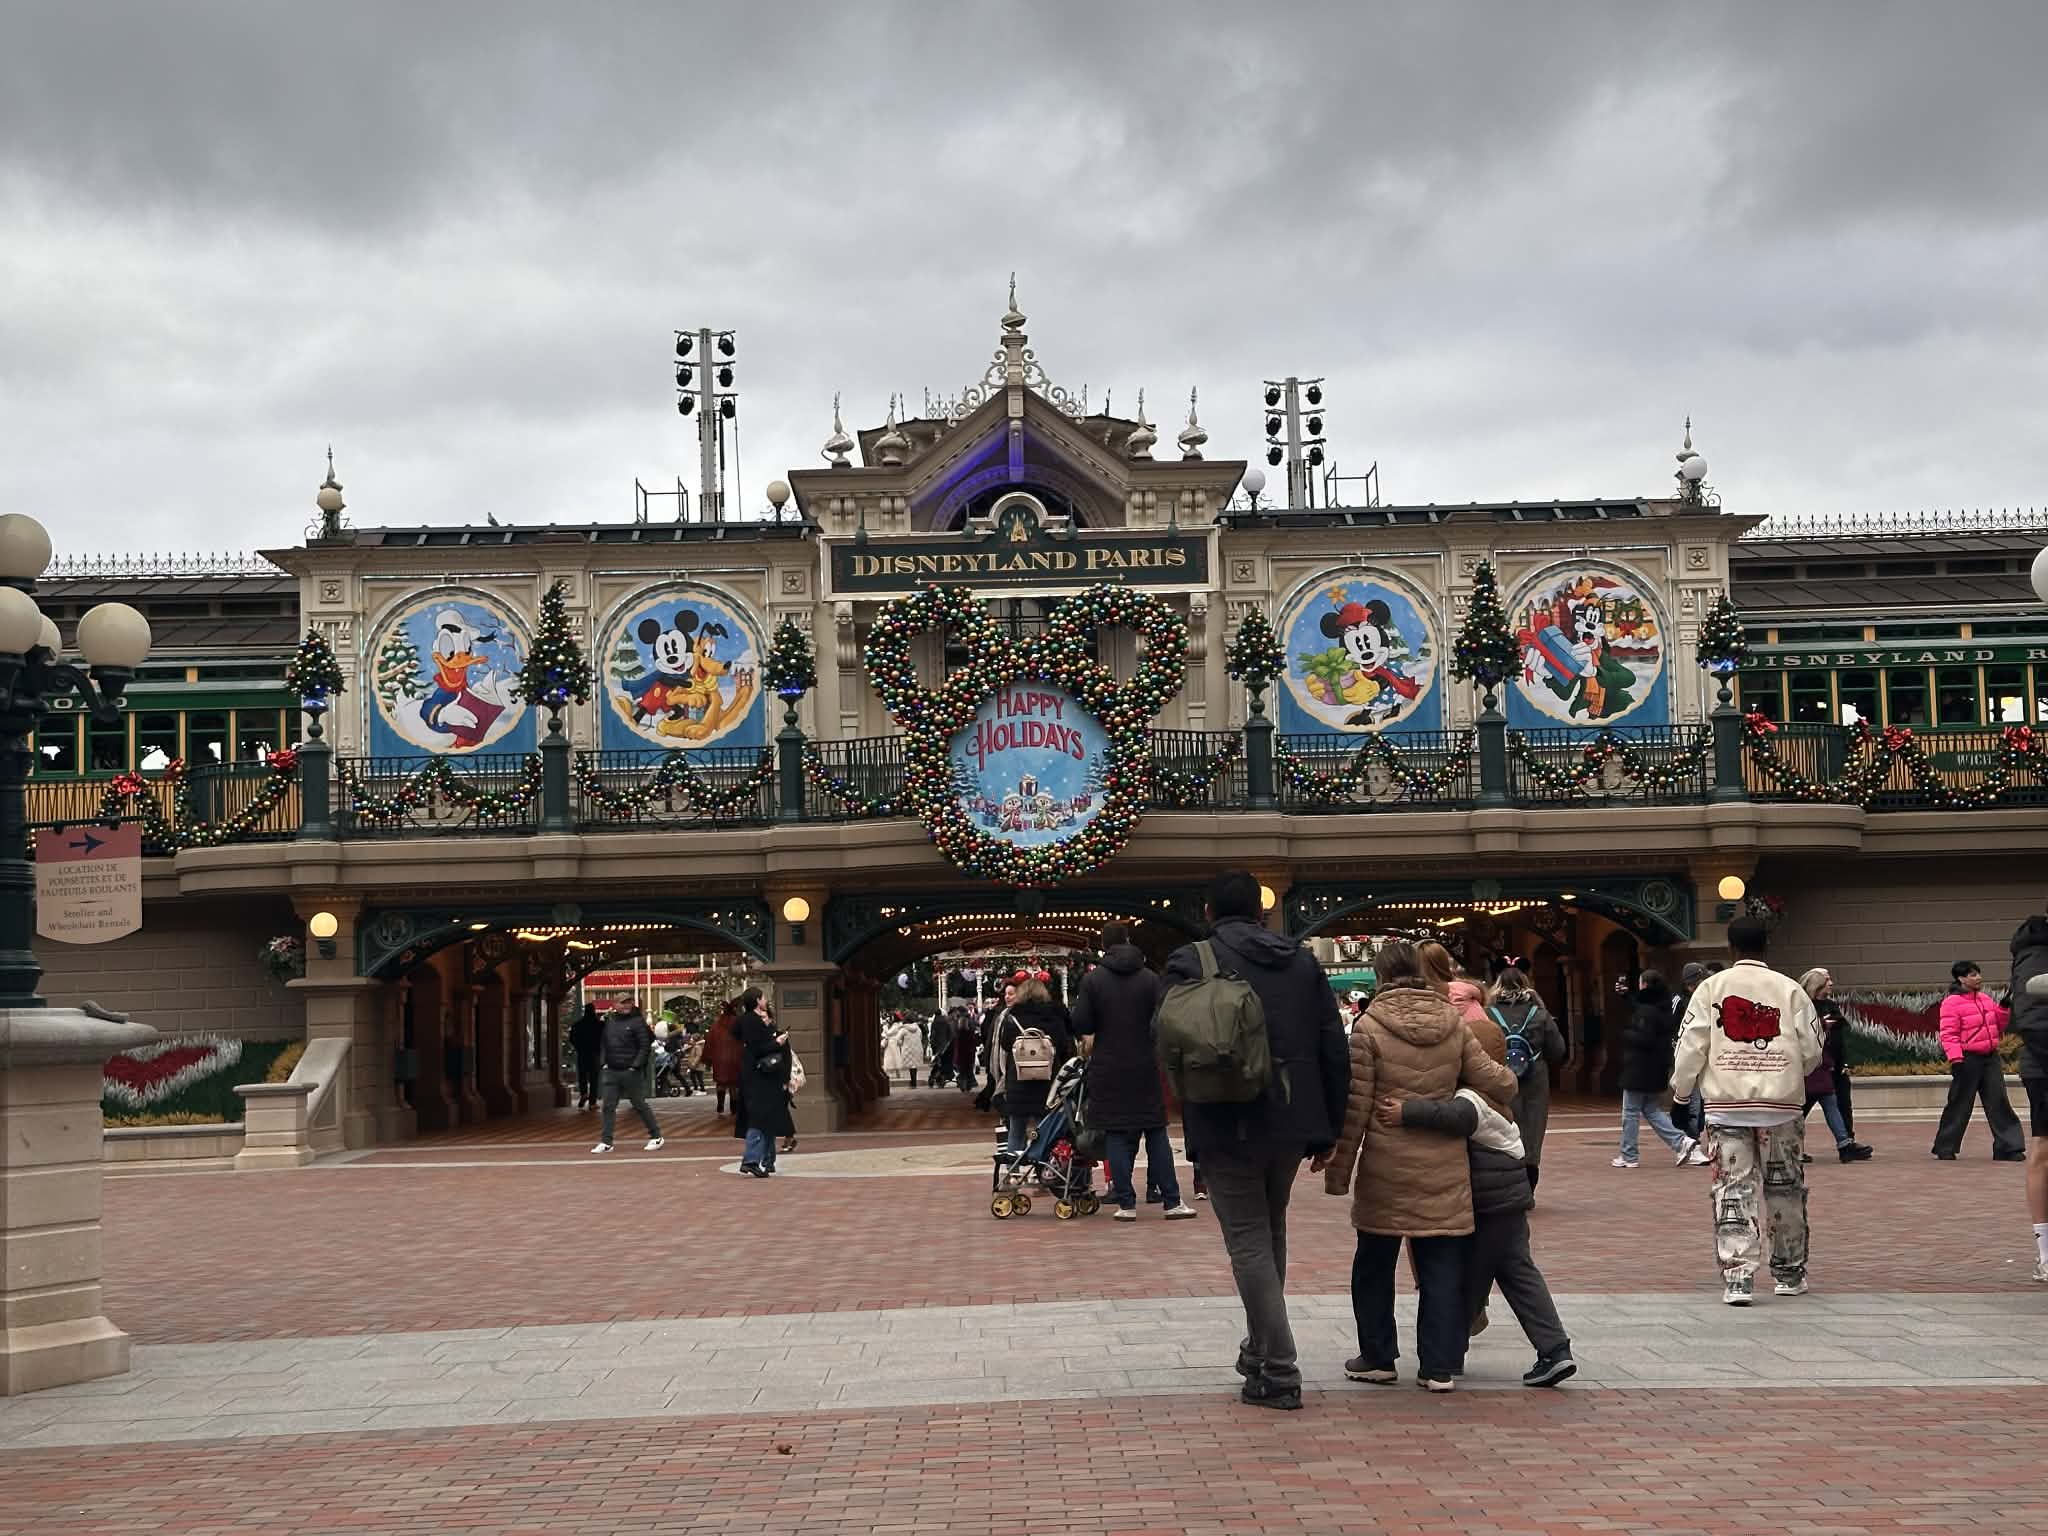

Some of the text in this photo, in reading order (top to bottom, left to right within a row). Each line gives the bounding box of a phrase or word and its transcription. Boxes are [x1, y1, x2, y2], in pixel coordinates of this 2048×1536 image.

[851, 548, 1186, 577] DISNEYLAND PARIS
[996, 687, 1064, 720] HAPPY
[965, 719, 1085, 772] HOLIDAYS
[58, 863, 118, 875] LOCATION DE
[49, 873, 127, 886] POUSSETTES ET DE
[89, 884, 137, 895] ROULANTS
[64, 907, 113, 918] Stroller and
[48, 918, 130, 930] Wheelchair Rentals
